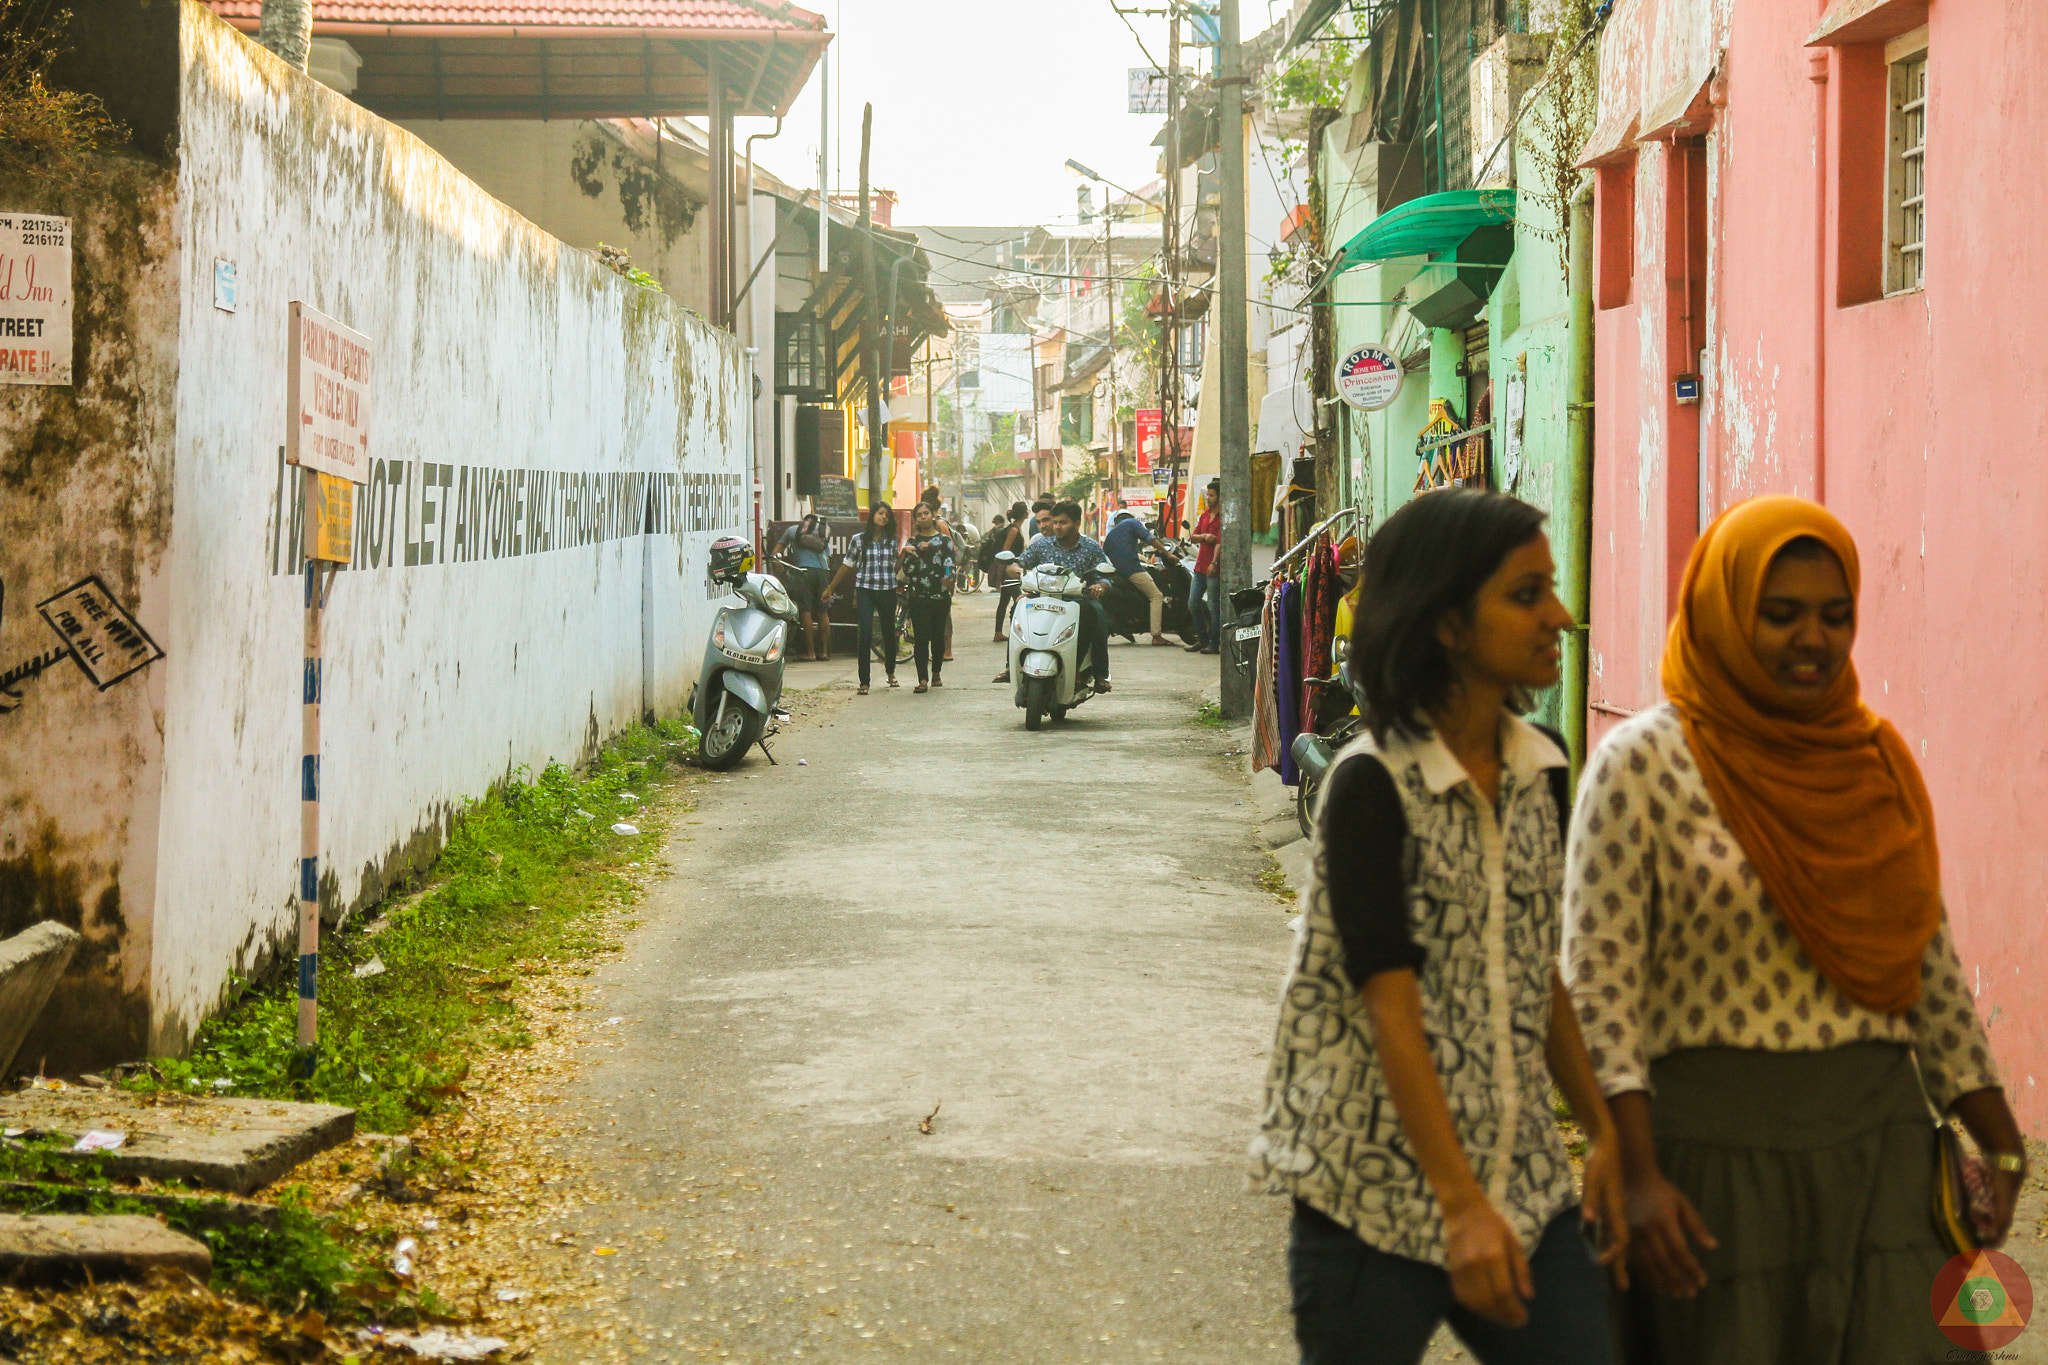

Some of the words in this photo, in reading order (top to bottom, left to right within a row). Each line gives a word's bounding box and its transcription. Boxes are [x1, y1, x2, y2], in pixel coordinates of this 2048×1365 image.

[22, 233, 65, 247] 2216172
[16, 254, 54, 302] Inn
[327, 330, 339, 373] FOR
[1343, 349, 1392, 373] ROOMS
[1353, 366, 1370, 375] HOME
[1370, 364, 1383, 372] STAY
[313, 371, 344, 422] VEHICLES
[344, 386, 360, 429] ONLY
[352, 456, 404, 571] NOT
[404, 460, 453, 567] LET
[453, 464, 525, 564] ANYONE
[525, 469, 558, 555] WALK
[558, 471, 606, 547] THROUGH
[75, 592, 108, 622] FREE
[54, 610, 84, 637] FOR
[76, 638, 105, 666] ALL
